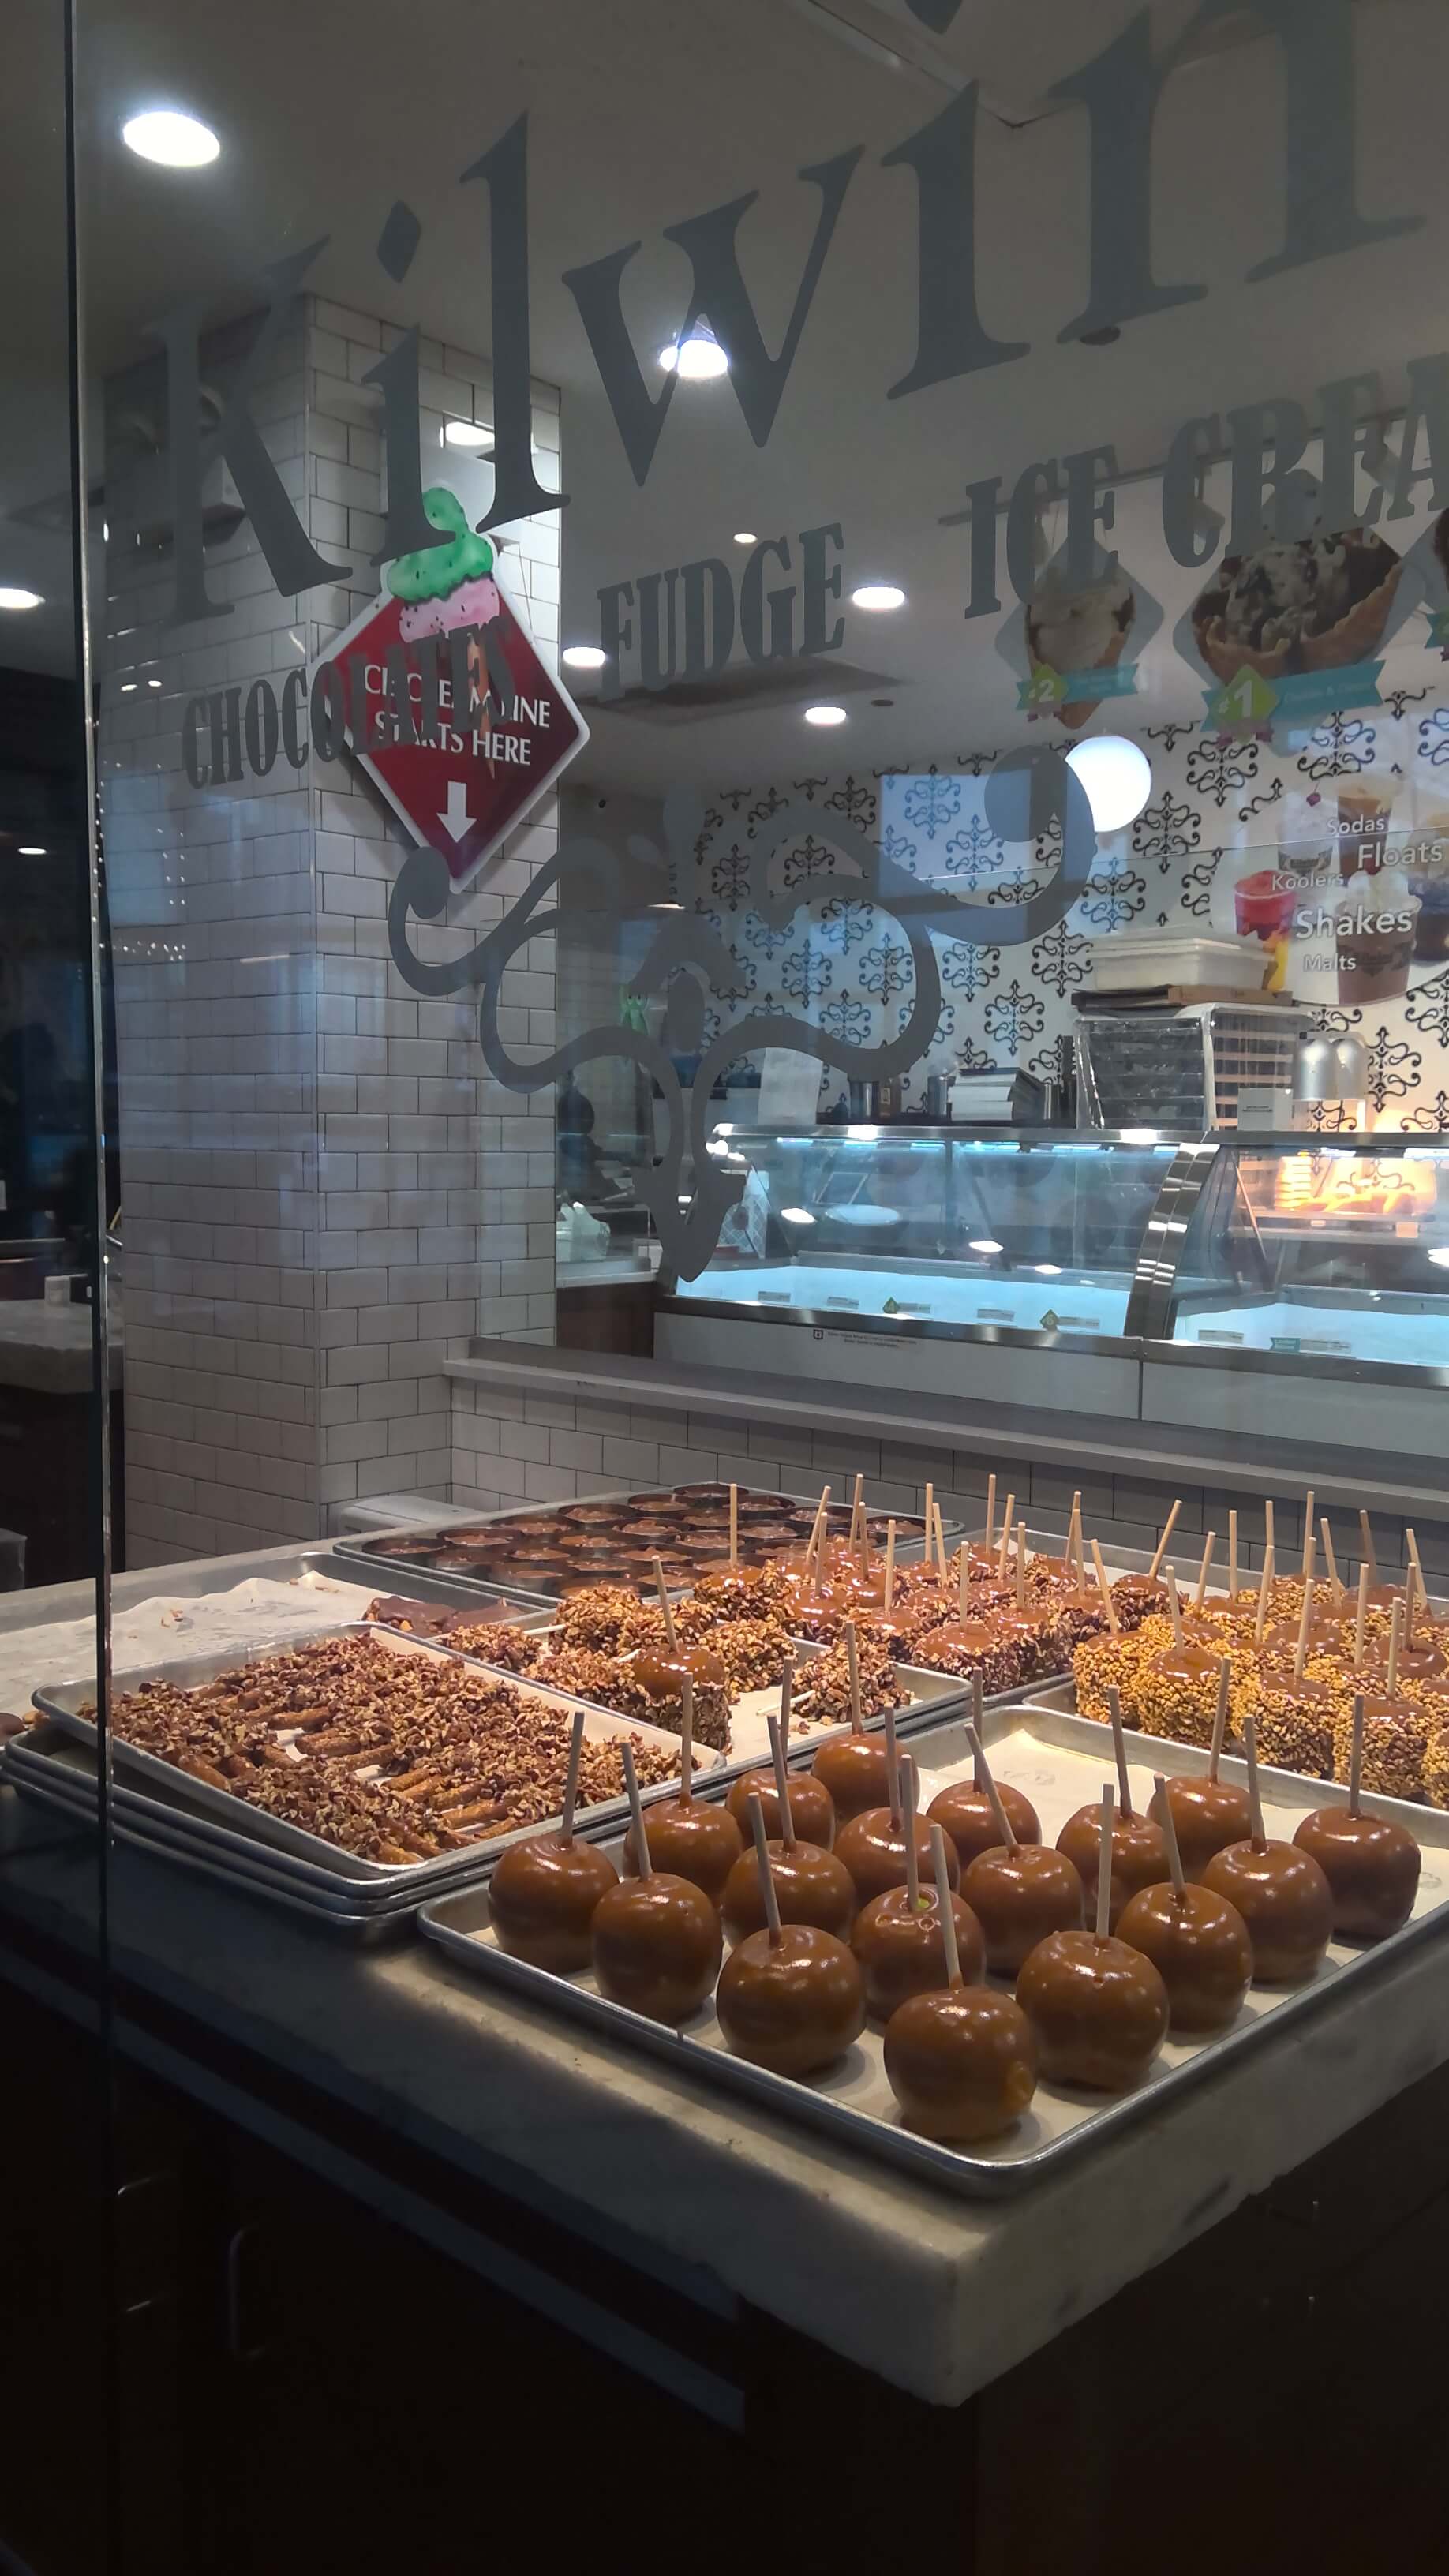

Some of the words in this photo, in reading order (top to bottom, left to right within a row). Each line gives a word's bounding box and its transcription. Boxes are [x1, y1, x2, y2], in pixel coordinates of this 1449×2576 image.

[964, 444, 1119, 619] ICE
[597, 522, 845, 702] FUDGE
[472, 729, 531, 766] HERE
[1327, 814, 1385, 836] Sodas
[1357, 841, 1443, 869] Floats
[1271, 871, 1345, 892] Koolers
[1295, 904, 1413, 941] Shakes
[1303, 953, 1357, 973] Malts
